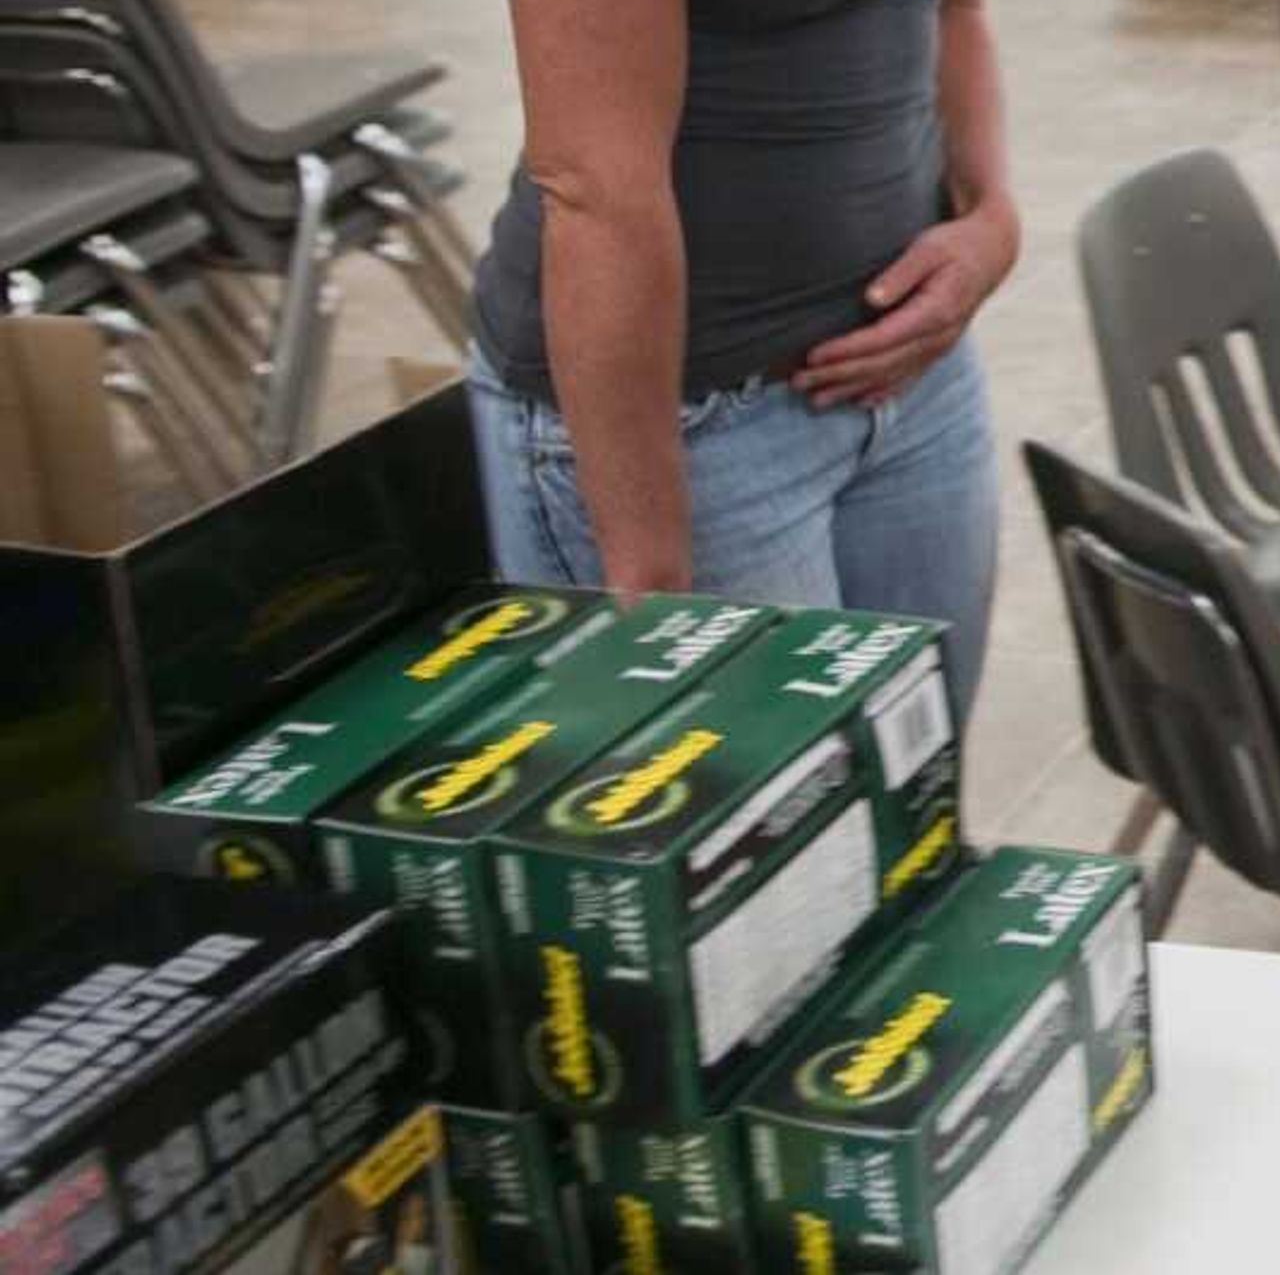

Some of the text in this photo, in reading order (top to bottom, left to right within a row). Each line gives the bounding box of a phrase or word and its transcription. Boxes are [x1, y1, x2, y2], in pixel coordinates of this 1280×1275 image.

[620, 606, 762, 681] Latex
[783, 623, 923, 698] Latex
[998, 862, 1120, 947] Latex
